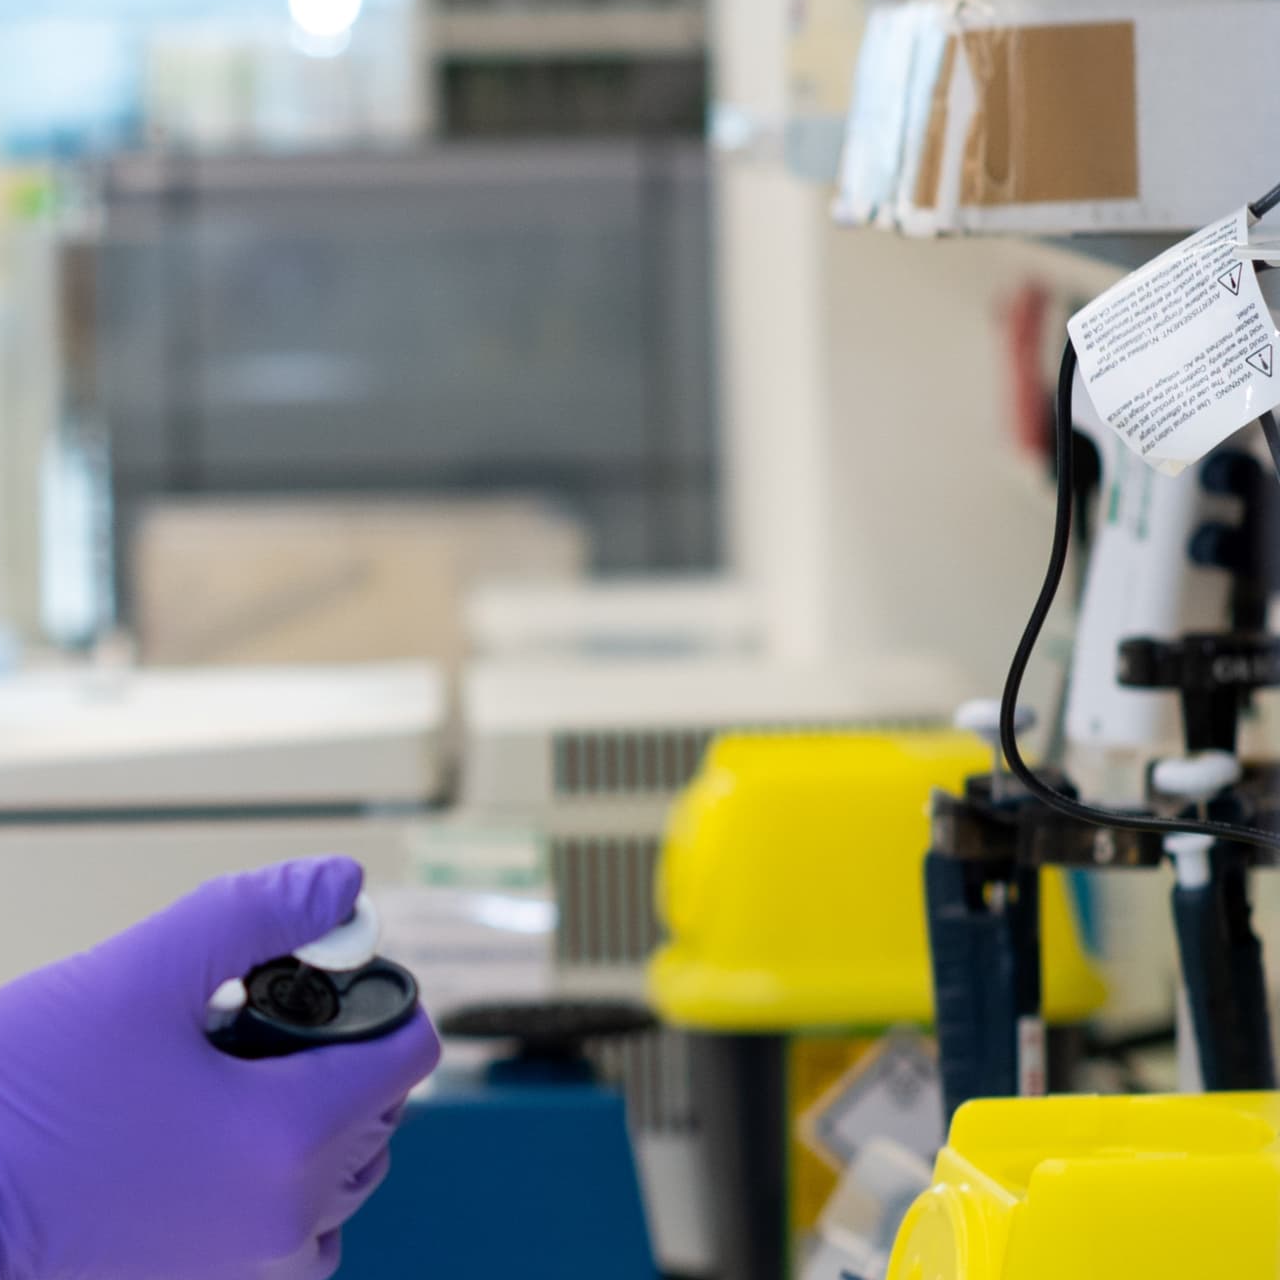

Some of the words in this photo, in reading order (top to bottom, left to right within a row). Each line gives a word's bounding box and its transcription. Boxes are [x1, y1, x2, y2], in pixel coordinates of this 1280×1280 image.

[1208, 256, 1237, 278] hargeur
[1183, 287, 1209, 310] batterie
[1233, 311, 1260, 335] adapter
[1247, 322, 1264, 337] void
[1204, 331, 1234, 355] matches
[1247, 332, 1269, 350] could
[1219, 345, 1249, 369] damage
[1152, 369, 1180, 389] voltage
[1178, 363, 1208, 386] Confirm
[1183, 374, 1209, 393] battery
[1163, 382, 1179, 396] that
[1127, 399, 1152, 420] voltage
[1149, 394, 1176, 417] product
[1172, 408, 1196, 428] original
